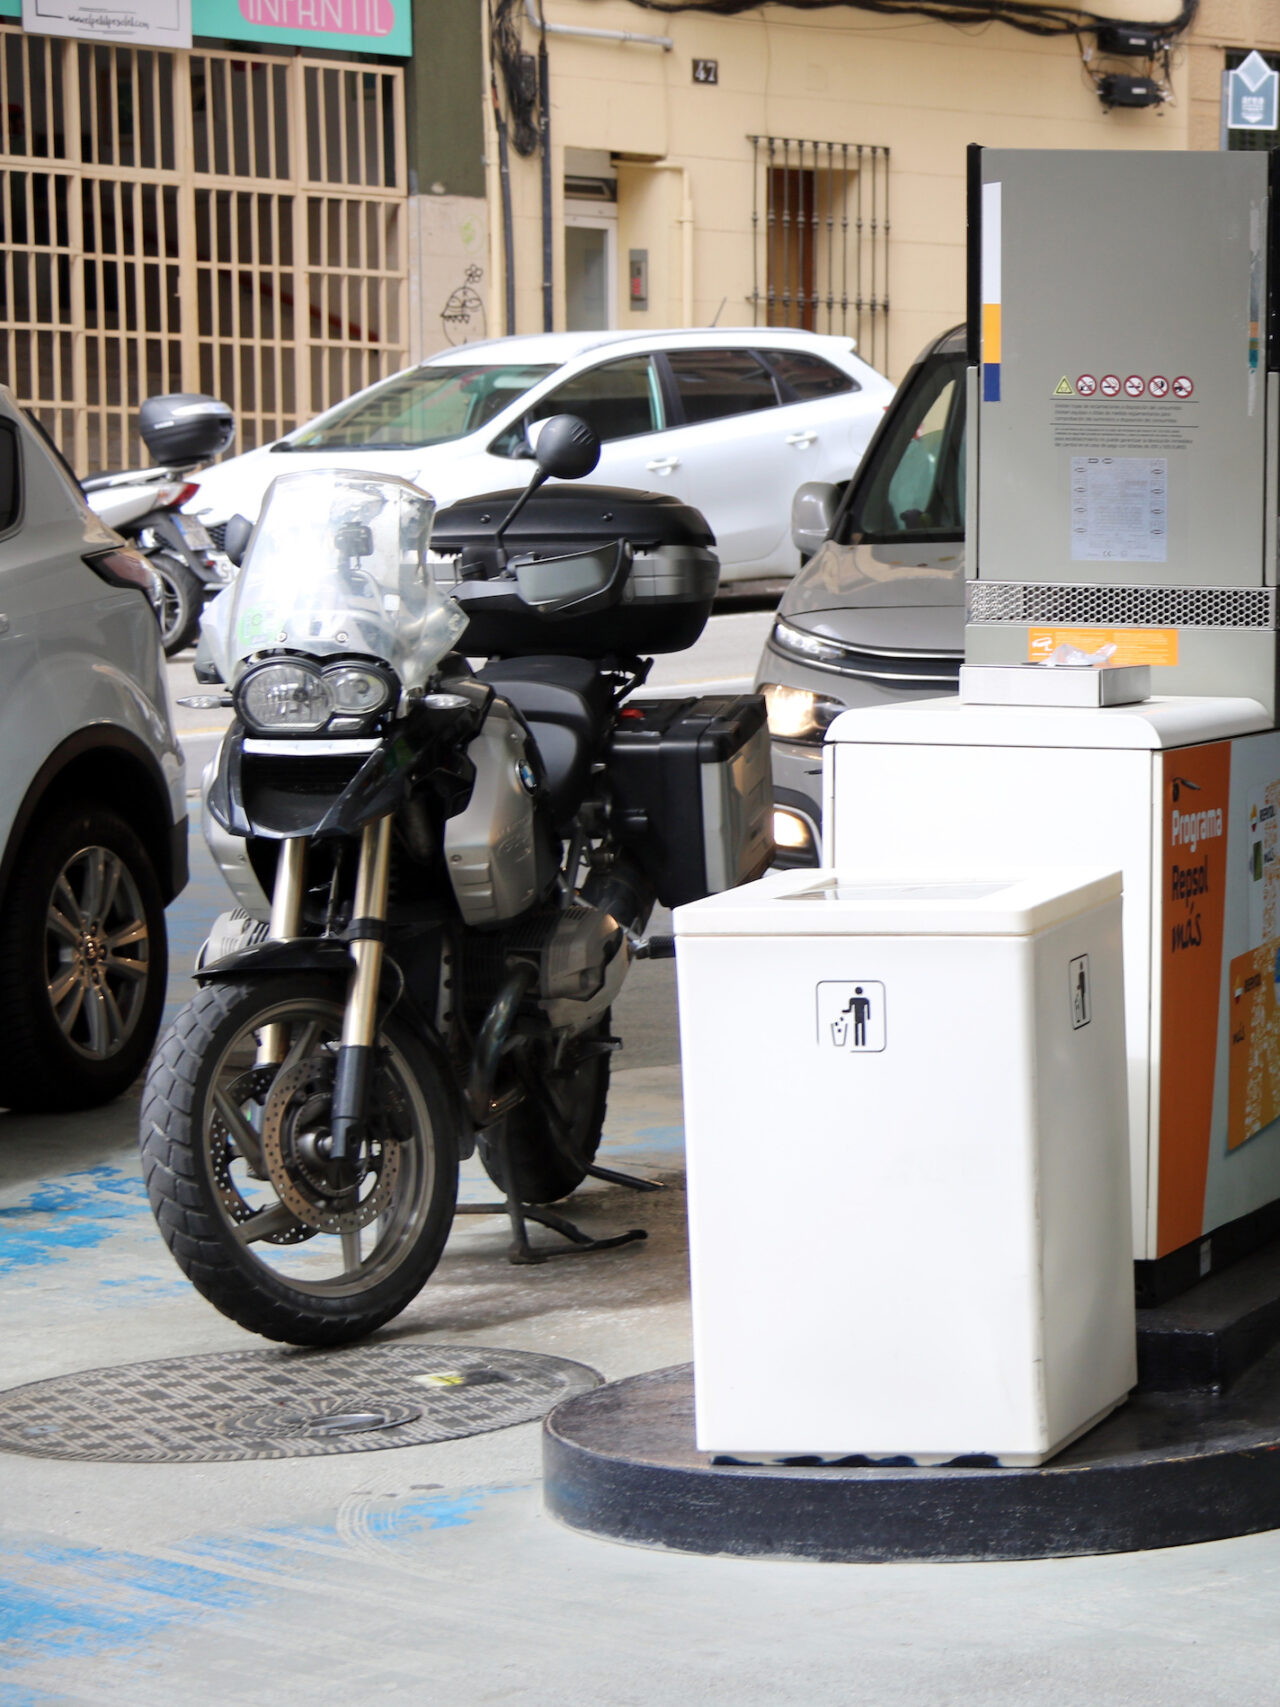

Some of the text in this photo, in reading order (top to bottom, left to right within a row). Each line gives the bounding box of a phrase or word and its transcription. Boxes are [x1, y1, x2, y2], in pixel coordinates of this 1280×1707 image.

[694, 60, 716, 82] 47
[1171, 808, 1223, 853] Programa
[1171, 854, 1209, 908] Repsol
[1171, 901, 1202, 953] más
